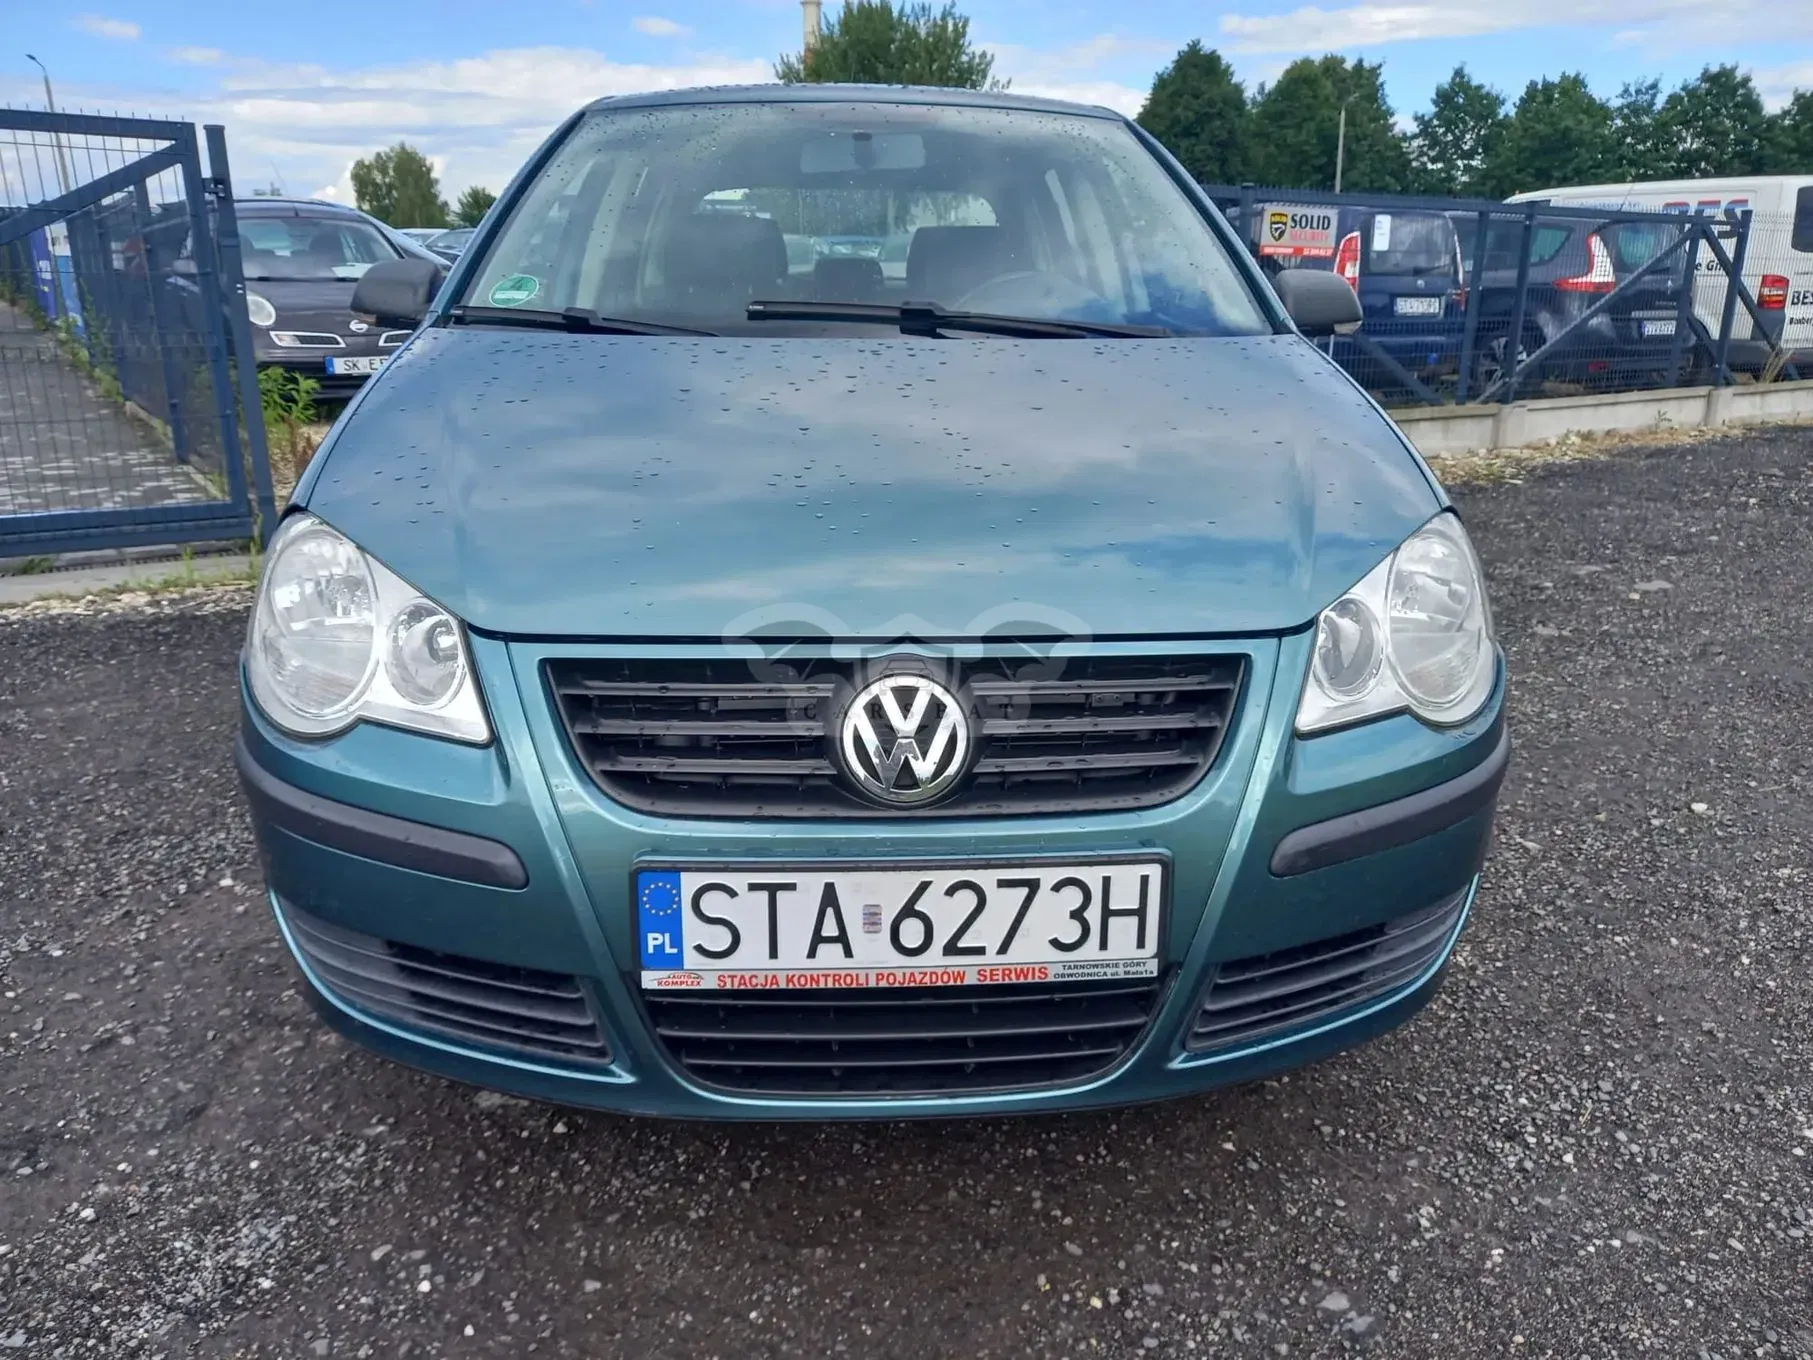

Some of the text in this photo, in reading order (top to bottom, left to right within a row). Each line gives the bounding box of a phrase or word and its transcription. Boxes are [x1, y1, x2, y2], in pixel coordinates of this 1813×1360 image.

[1291, 214, 1331, 230] SOLID
[1791, 290, 1813, 306] BE
[344, 359, 360, 371] SK
[691, 874, 1149, 960] STA 6273H
[647, 933, 678, 954] PL
[1062, 960, 1147, 970] TARNOWSKIE GÓRY
[717, 967, 1049, 988] STACJA KONTROLI POJAZDÓW SERWIS
[1054, 970, 1108, 979] OBWODNICA
